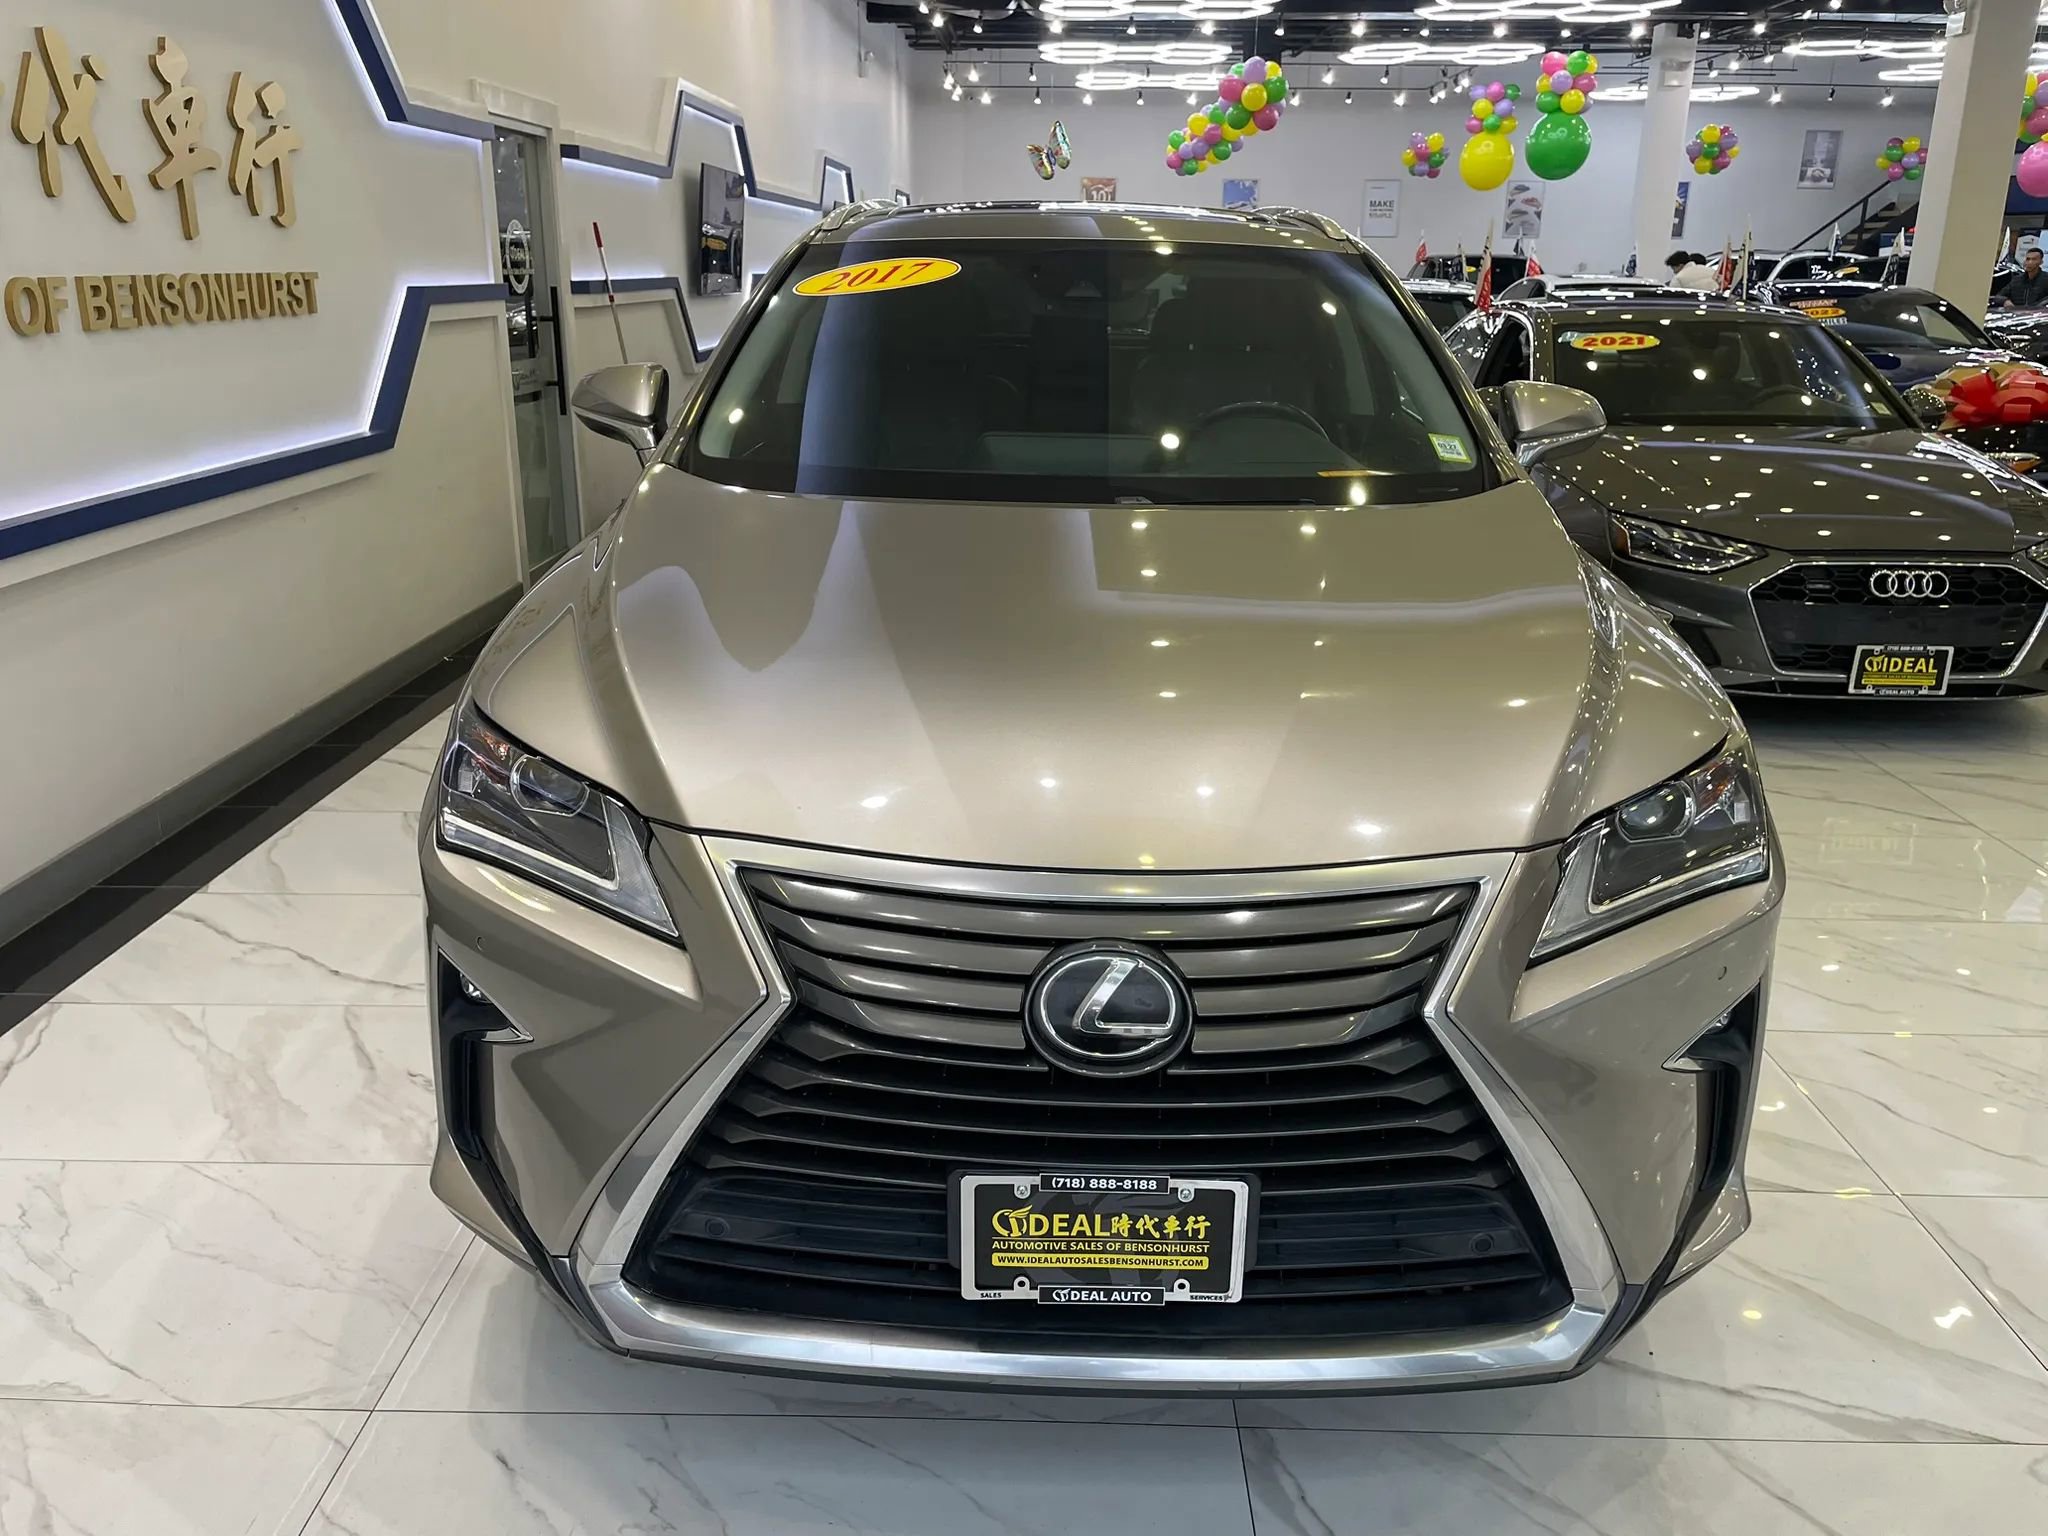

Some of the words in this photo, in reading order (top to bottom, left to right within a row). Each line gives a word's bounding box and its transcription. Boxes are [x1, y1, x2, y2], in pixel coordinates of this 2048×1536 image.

[0, 26, 304, 240] 代車行
[1369, 200, 1395, 208] MAKE
[818, 261, 936, 292] 2017
[4, 276, 69, 337] OF
[74, 271, 319, 333] BENSONHURST
[1582, 336, 1646, 348] 2021
[1881, 657, 1938, 673] IDEAL
[1051, 1177, 1086, 1189] (718)
[1089, 1178, 1158, 1190] 888-8188
[992, 1241, 1068, 1251] AUTOMOTIVE
[1070, 1241, 1104, 1251] SALES
[1106, 1242, 1122, 1251] OF
[1124, 1243, 1210, 1253] BENSONHURST
[997, 1256, 1204, 1267] WWW.IDEALAUTOSALESBENSONHURST.COM
[1111, 1291, 1152, 1302] AUTO
